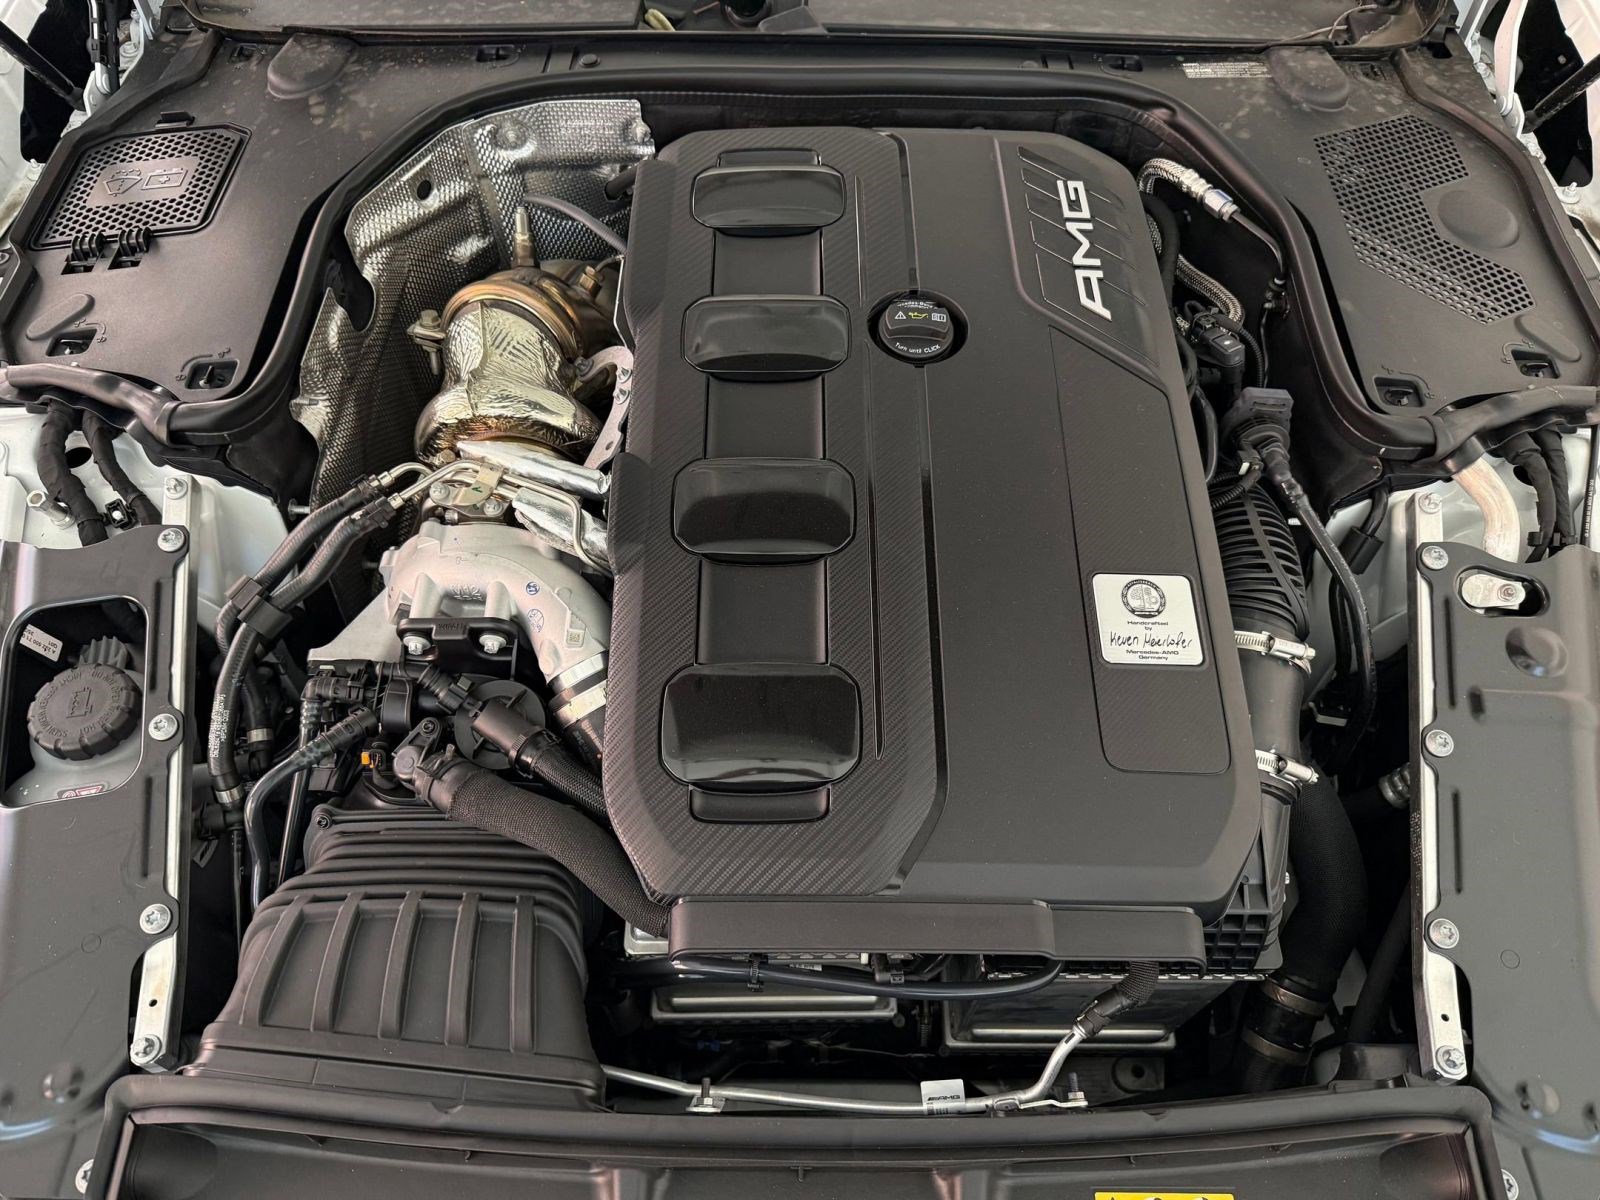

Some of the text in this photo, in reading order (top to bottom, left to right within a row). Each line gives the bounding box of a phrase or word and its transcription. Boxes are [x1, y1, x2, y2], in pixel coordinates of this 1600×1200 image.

[1056, 180, 1112, 322] AMG
[895, 342, 907, 351] Turn
[924, 344, 941, 353] CLICK
